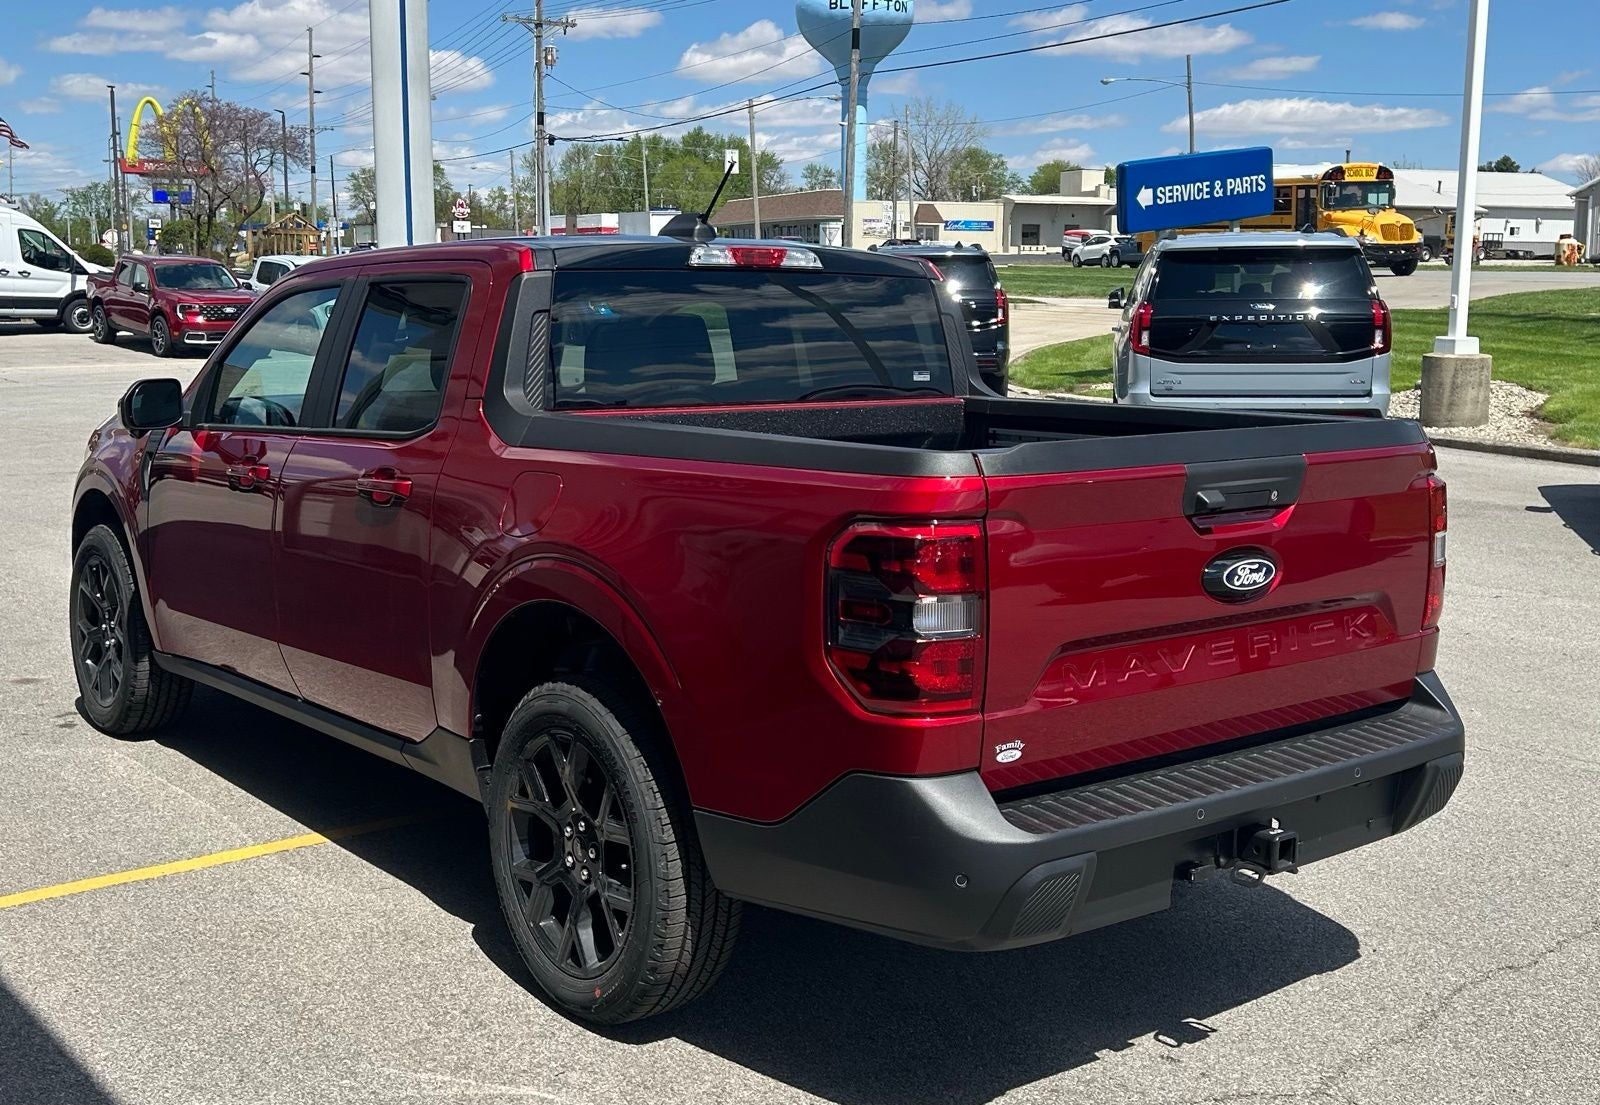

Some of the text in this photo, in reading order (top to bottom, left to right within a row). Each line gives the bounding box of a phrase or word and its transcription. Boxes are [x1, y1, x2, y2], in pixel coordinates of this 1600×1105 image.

[829, 0, 908, 13] BLFFTON
[1346, 168, 1374, 178] SCHOOL BUS
[1156, 174, 1266, 205] SERVICE & PARTS
[1233, 563, 1267, 587] Ford
[1062, 612, 1373, 694] MAVERICK
[995, 739, 1026, 754] Family
